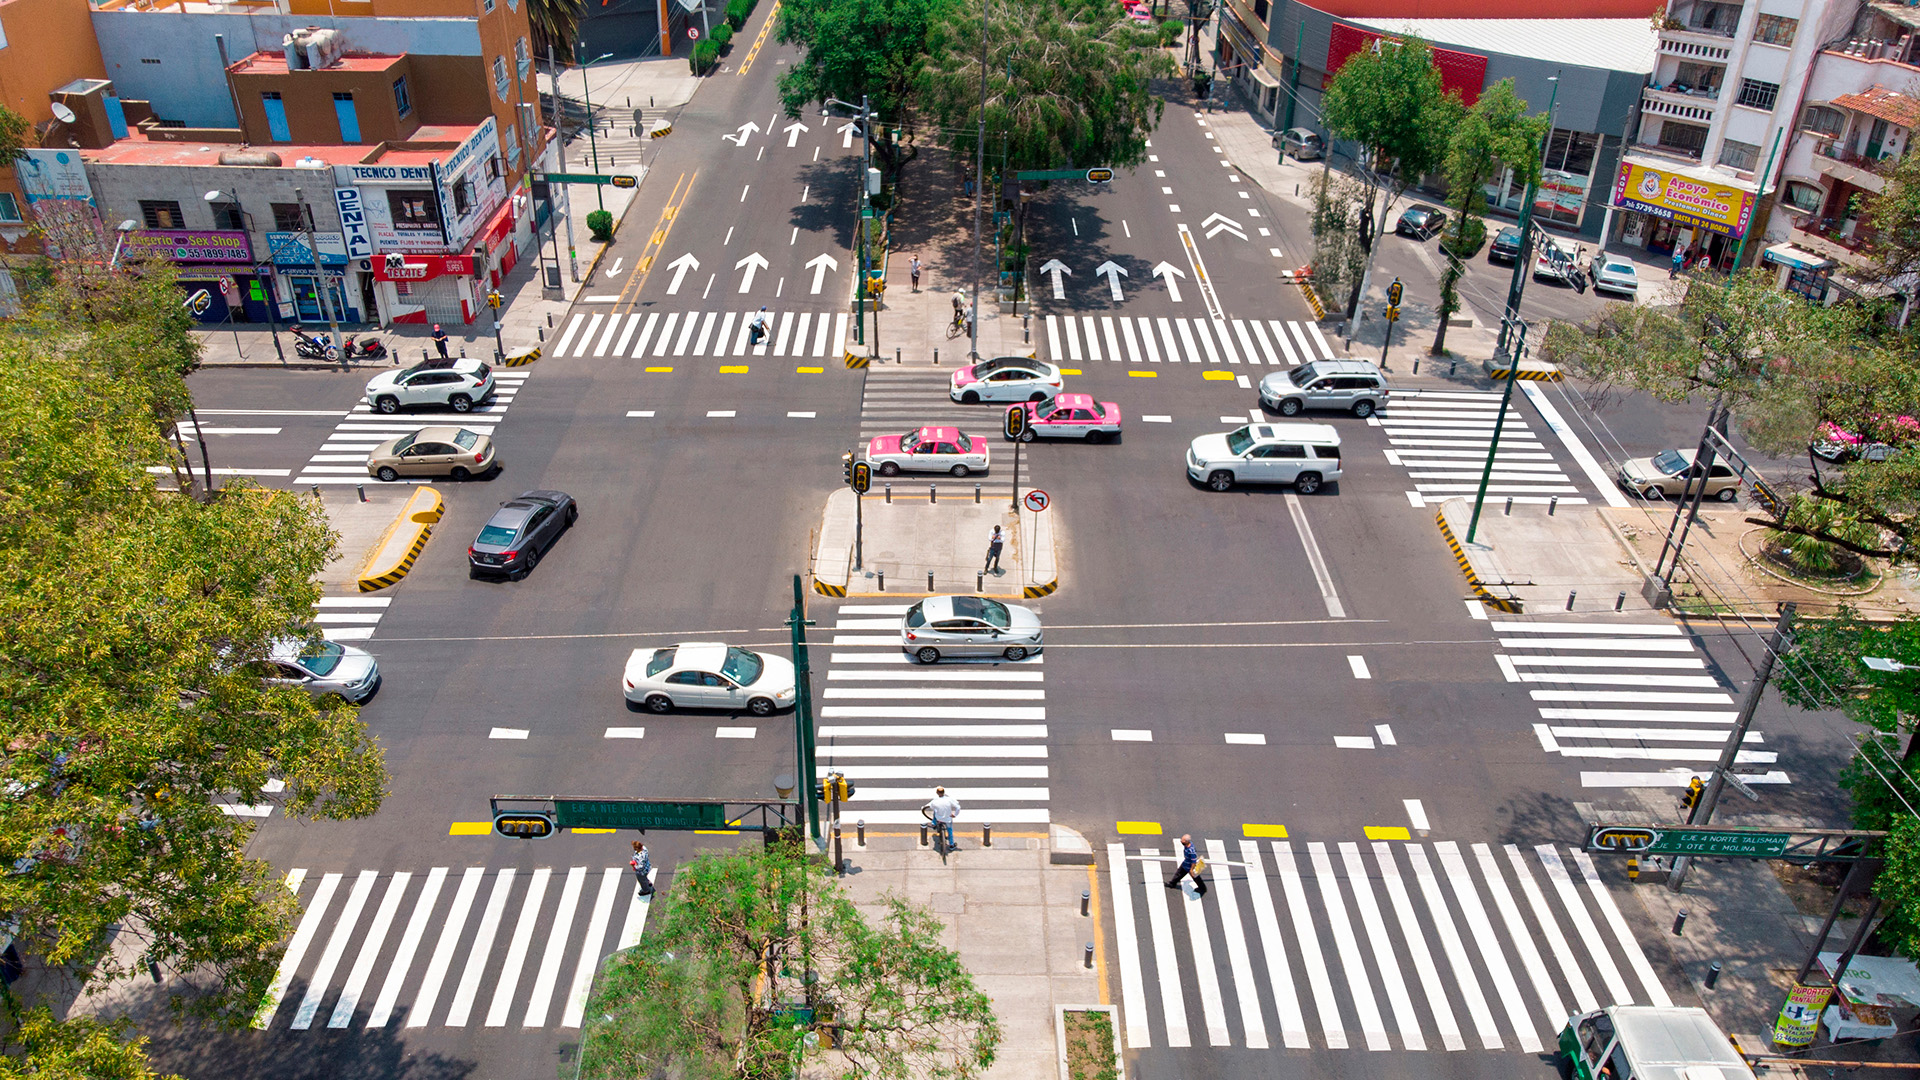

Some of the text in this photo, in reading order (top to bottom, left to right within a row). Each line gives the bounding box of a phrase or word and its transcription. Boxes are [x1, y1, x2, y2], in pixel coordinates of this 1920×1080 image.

[445, 121, 494, 175] TECNICO DENTAL
[352, 167, 432, 179] TECNICO DENT
[1617, 176, 1626, 199] AQUI
[1669, 177, 1709, 195] Apoyo
[436, 163, 453, 241] DENTAL
[1666, 188, 1730, 212] Económico
[1635, 203, 1672, 218] 5739-5658
[1674, 213, 1691, 224] HASTA
[1692, 218, 1700, 226] EN
[1701, 220, 1709, 228] 24
[1710, 222, 1730, 234] HORAS
[1702, 209, 1728, 220] Dinero
[1739, 207, 1750, 232] AQUI
[337, 190, 371, 257] DENTAL
[188, 235, 209, 246] Sex
[213, 236, 240, 248] Shop
[188, 249, 248, 259] 55-1899-7485
[387, 268, 422, 278] TECATE
[571, 804, 664, 814] EJE 4 NTE TALISMAN
[621, 816, 651, 825] ROBLES
[654, 817, 701, 826] DOMINGUEZ
[1742, 836, 1785, 844] TALISMAN
[1791, 995, 1825, 1003] PANTALLAS
